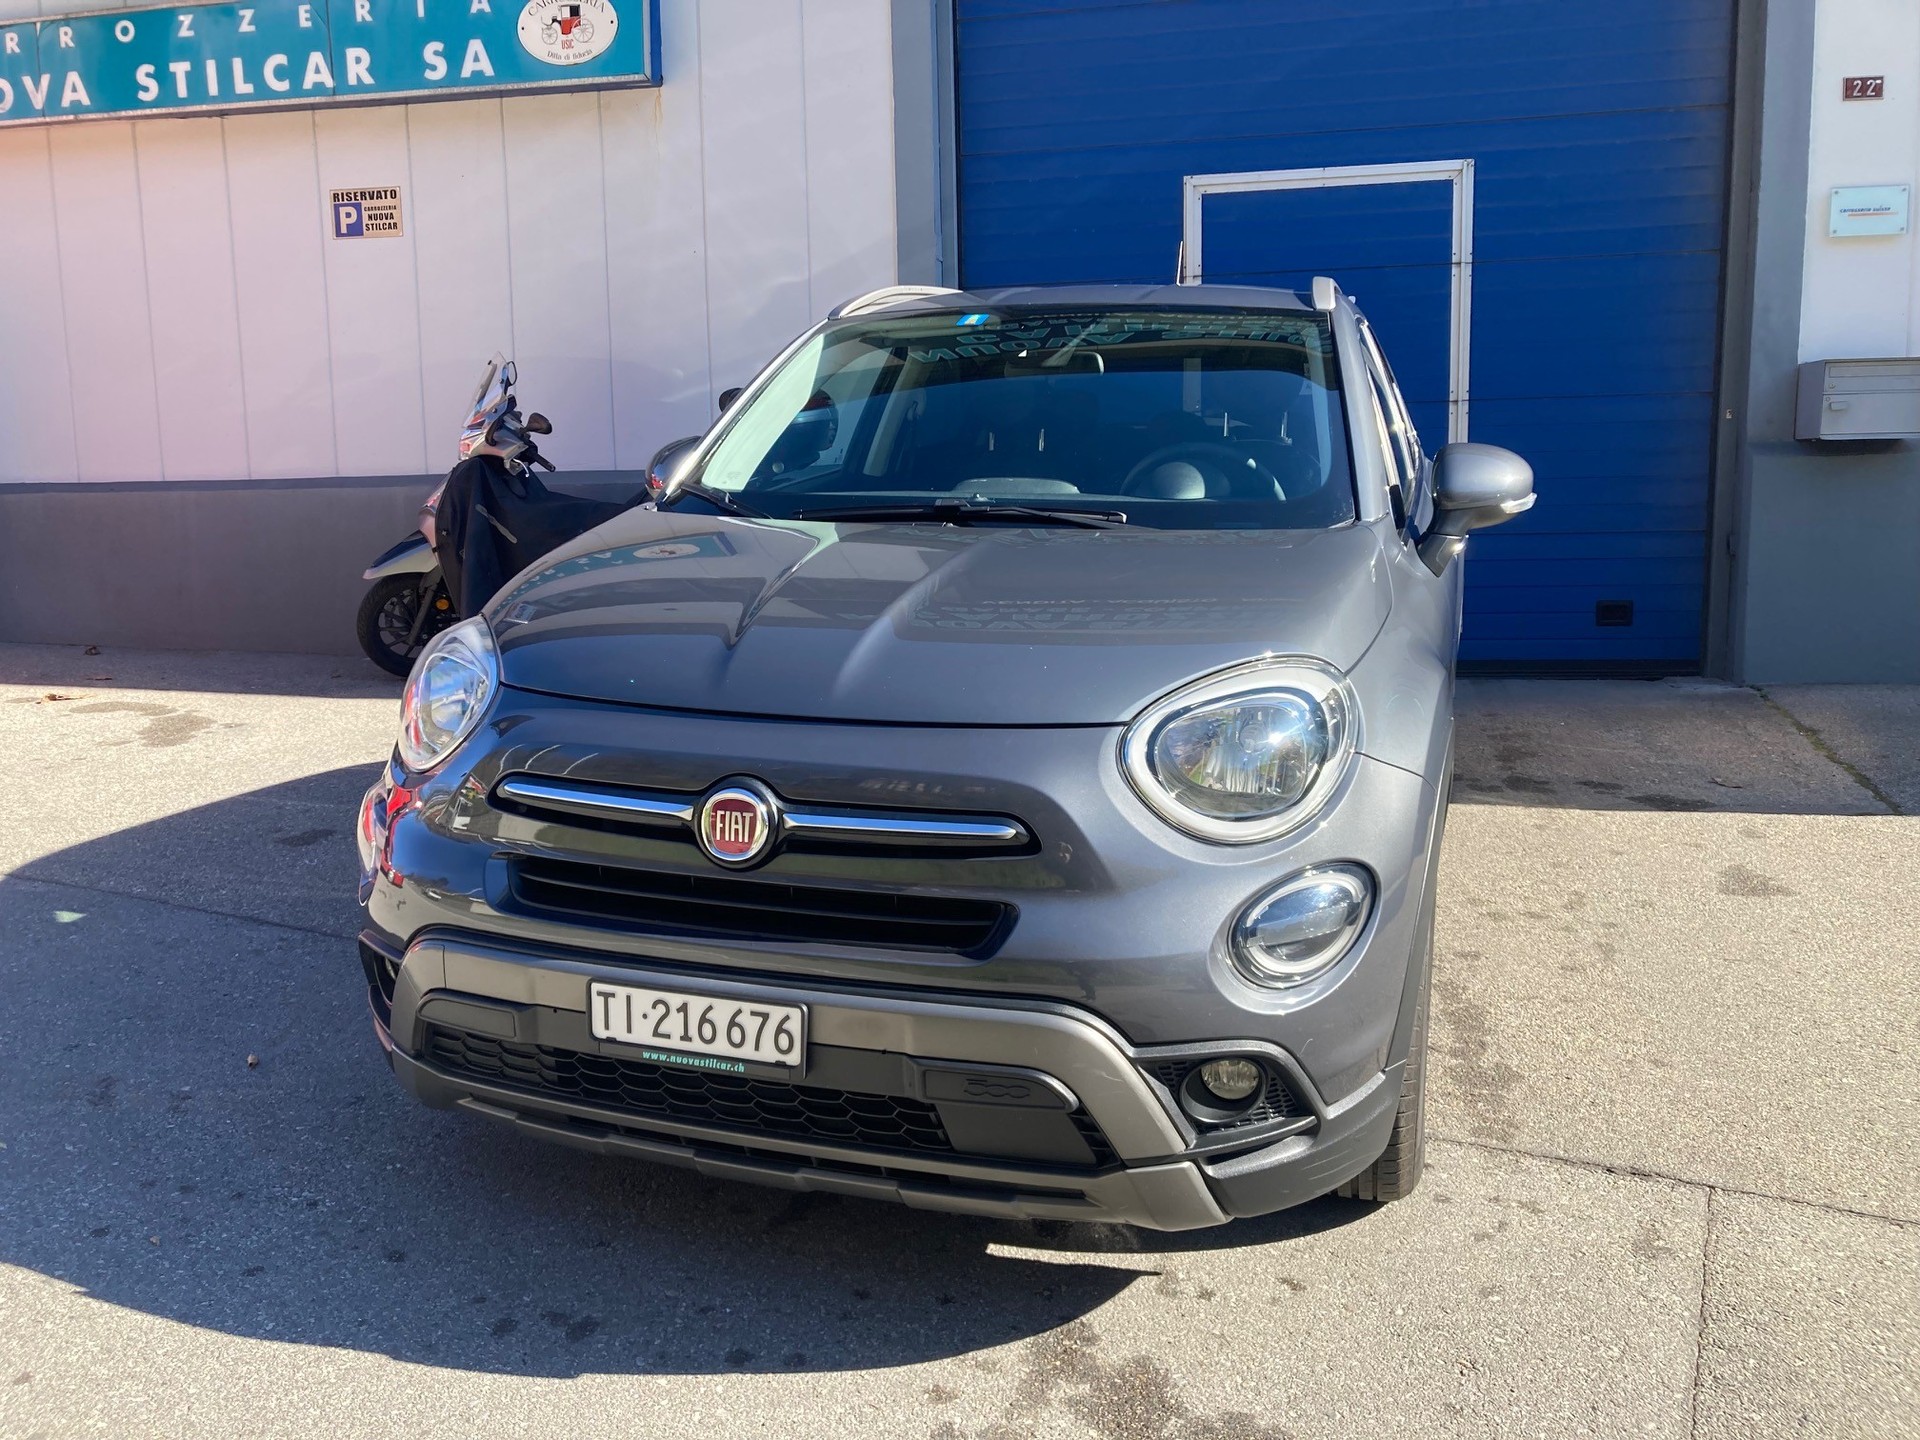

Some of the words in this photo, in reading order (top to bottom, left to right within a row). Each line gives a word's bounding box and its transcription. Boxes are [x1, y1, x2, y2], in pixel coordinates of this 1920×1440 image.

[135, 47, 376, 102] STILCAR
[423, 38, 495, 81] SA
[1853, 79, 1876, 96] 22
[333, 189, 397, 202] RISERVATO
[339, 206, 358, 234] P
[365, 222, 398, 231] STILCAR
[367, 212, 394, 221] NUOVA
[716, 810, 754, 843] FIAT
[642, 1050, 745, 1073] www.nuovastilcar.ch
